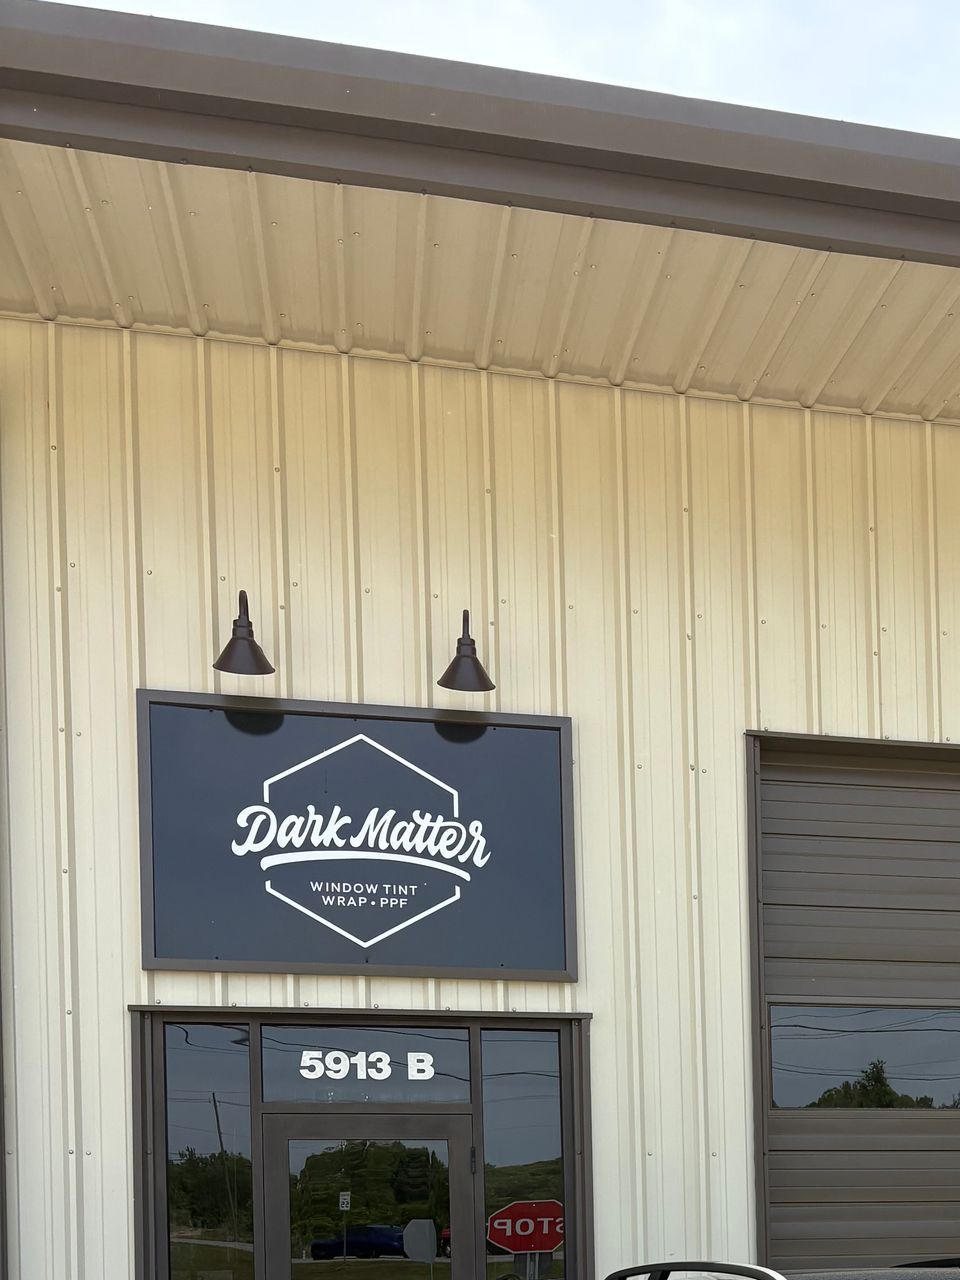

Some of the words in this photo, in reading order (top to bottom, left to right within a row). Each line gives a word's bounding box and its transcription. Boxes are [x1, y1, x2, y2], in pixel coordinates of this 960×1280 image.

[231, 804, 351, 857] Dark
[349, 807, 492, 868] Matter
[310, 881, 379, 895] WINDOW
[383, 883, 418, 896] TINT
[322, 895, 368, 907] WRAP
[379, 897, 409, 909] PPF
[299, 1050, 392, 1081] 5913
[407, 1052, 435, 1080] B
